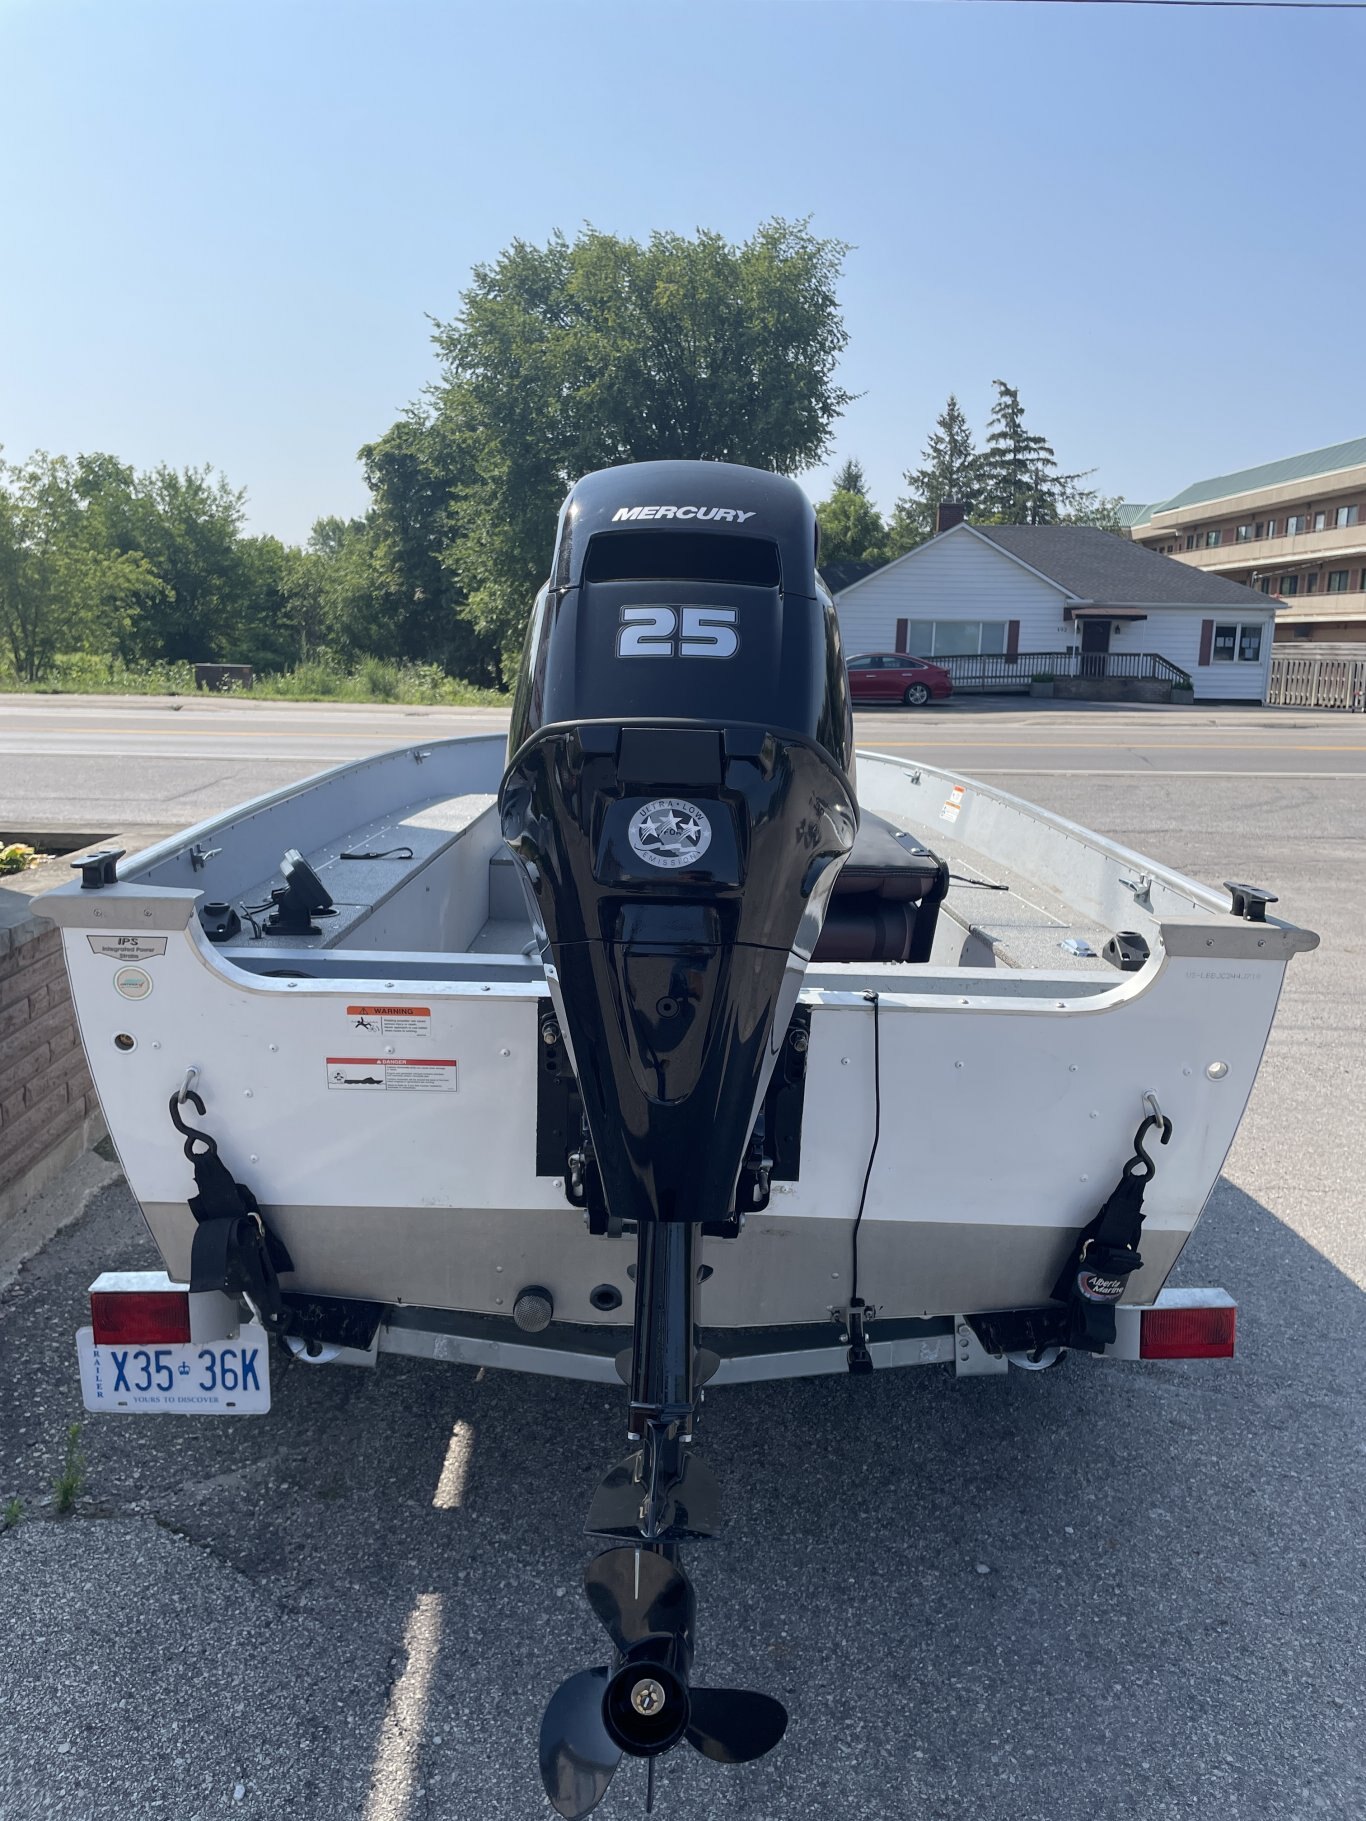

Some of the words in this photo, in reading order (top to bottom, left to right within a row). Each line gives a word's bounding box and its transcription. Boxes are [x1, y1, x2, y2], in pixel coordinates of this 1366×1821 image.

[612, 506, 756, 522] MERCURY
[616, 604, 740, 659] 25
[640, 801, 673, 817] ULTRA
[682, 804, 704, 820] LOW
[643, 851, 697, 866] EMISSION
[118, 938, 138, 946] IPS
[111, 1350, 174, 1392] X35
[198, 1349, 260, 1391] 36K
[133, 1396, 161, 1404] YOURS
[177, 1396, 219, 1404] DISCOVER
